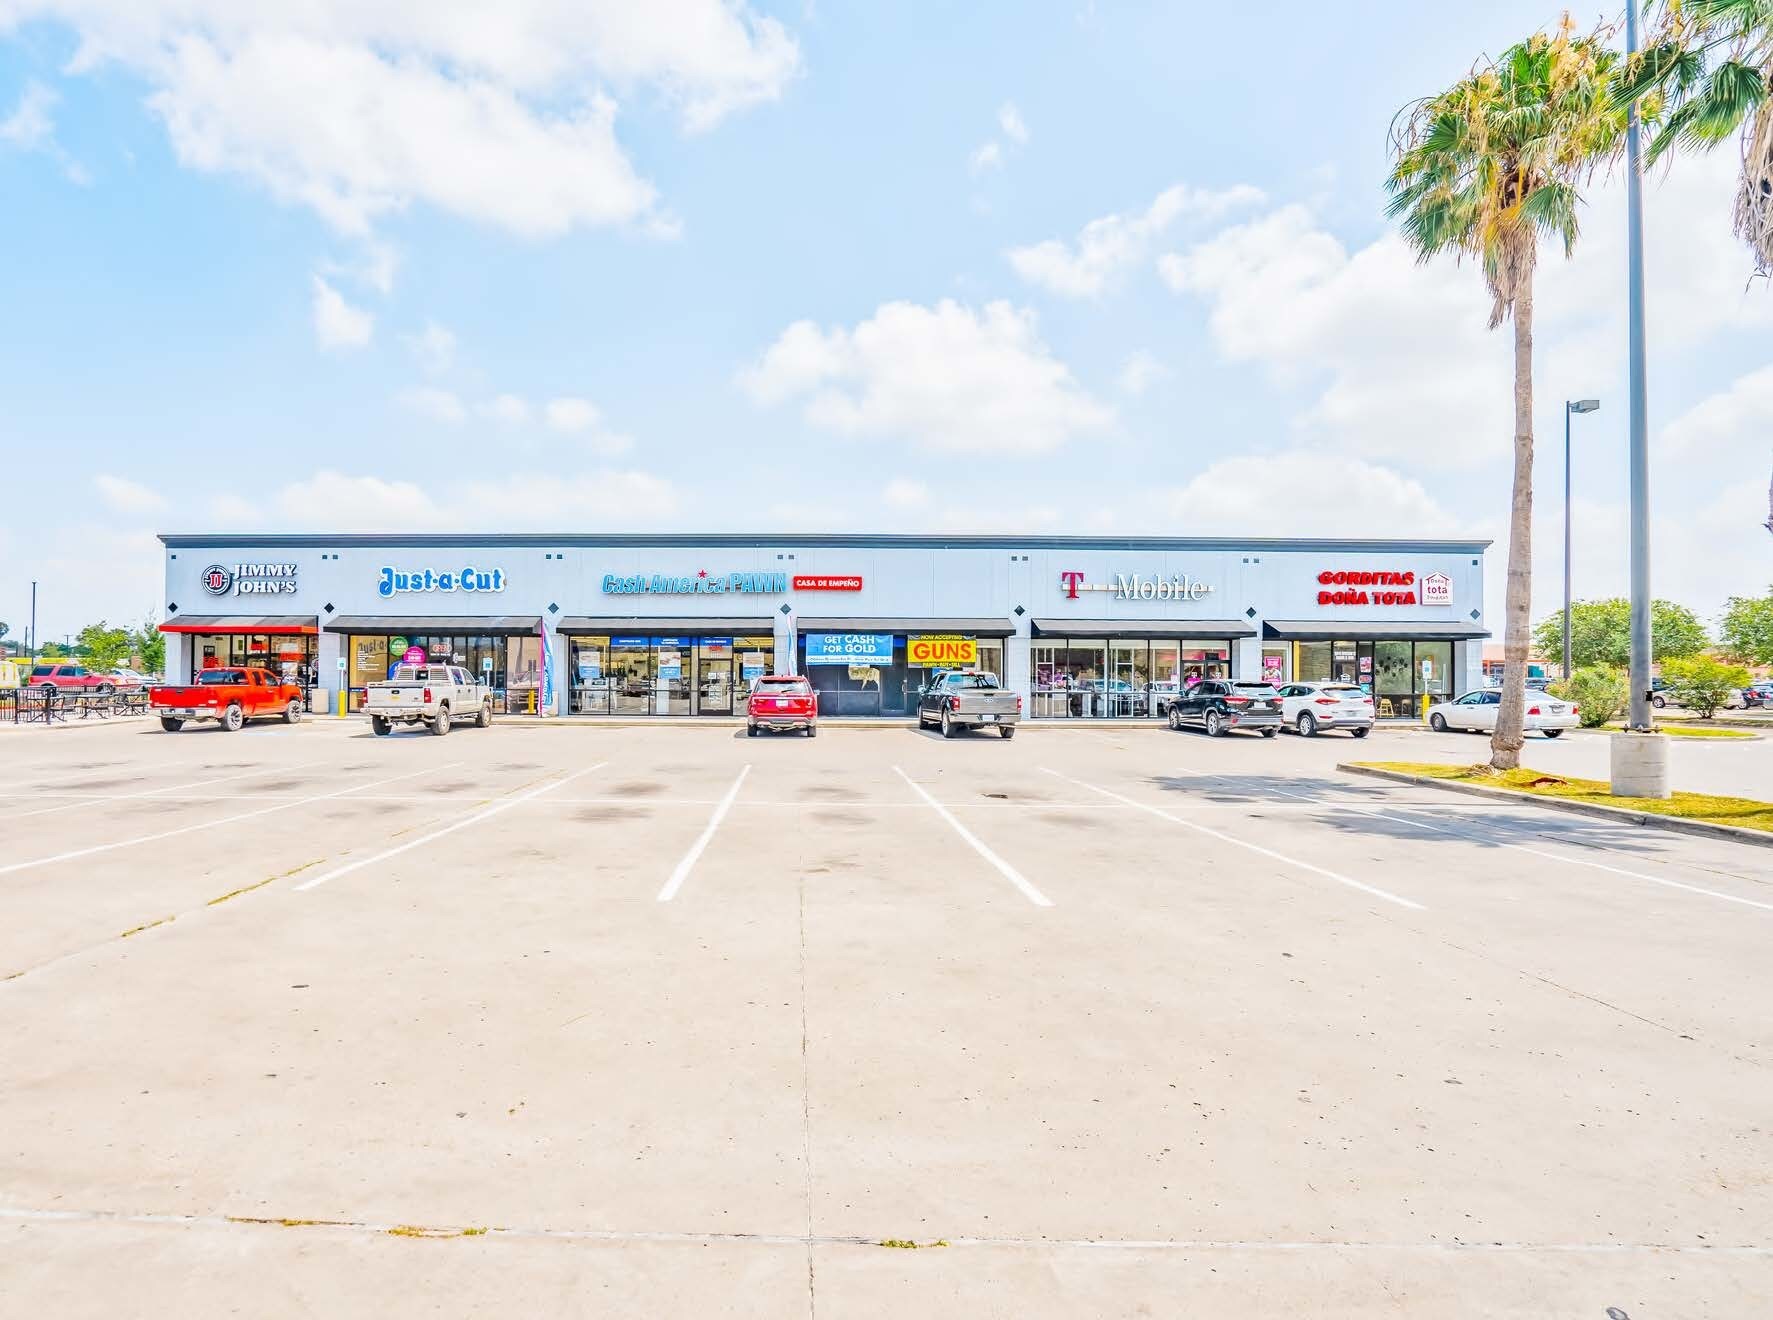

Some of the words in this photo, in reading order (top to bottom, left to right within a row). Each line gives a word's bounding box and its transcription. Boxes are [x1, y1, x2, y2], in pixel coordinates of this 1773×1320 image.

[233, 564, 297, 579] JIMMY
[1317, 571, 1415, 585] GORDITAS
[210, 573, 223, 588] JJ
[601, 574, 646, 594] Cash
[649, 571, 726, 594] America
[729, 571, 787, 593] PAWN
[796, 579, 816, 587] CASA
[818, 579, 827, 587] DE
[828, 578, 860, 587] EMPEÑO
[233, 581, 297, 596] JOHN'S
[1317, 587, 1369, 605] DOÑA
[1371, 591, 1416, 605] TOTA
[1427, 586, 1448, 594] tota
[824, 636, 842, 644] GET
[845, 634, 875, 645] CASH
[823, 645, 842, 653] FOR
[845, 644, 876, 653] GOLD
[913, 642, 972, 660] GUNS
